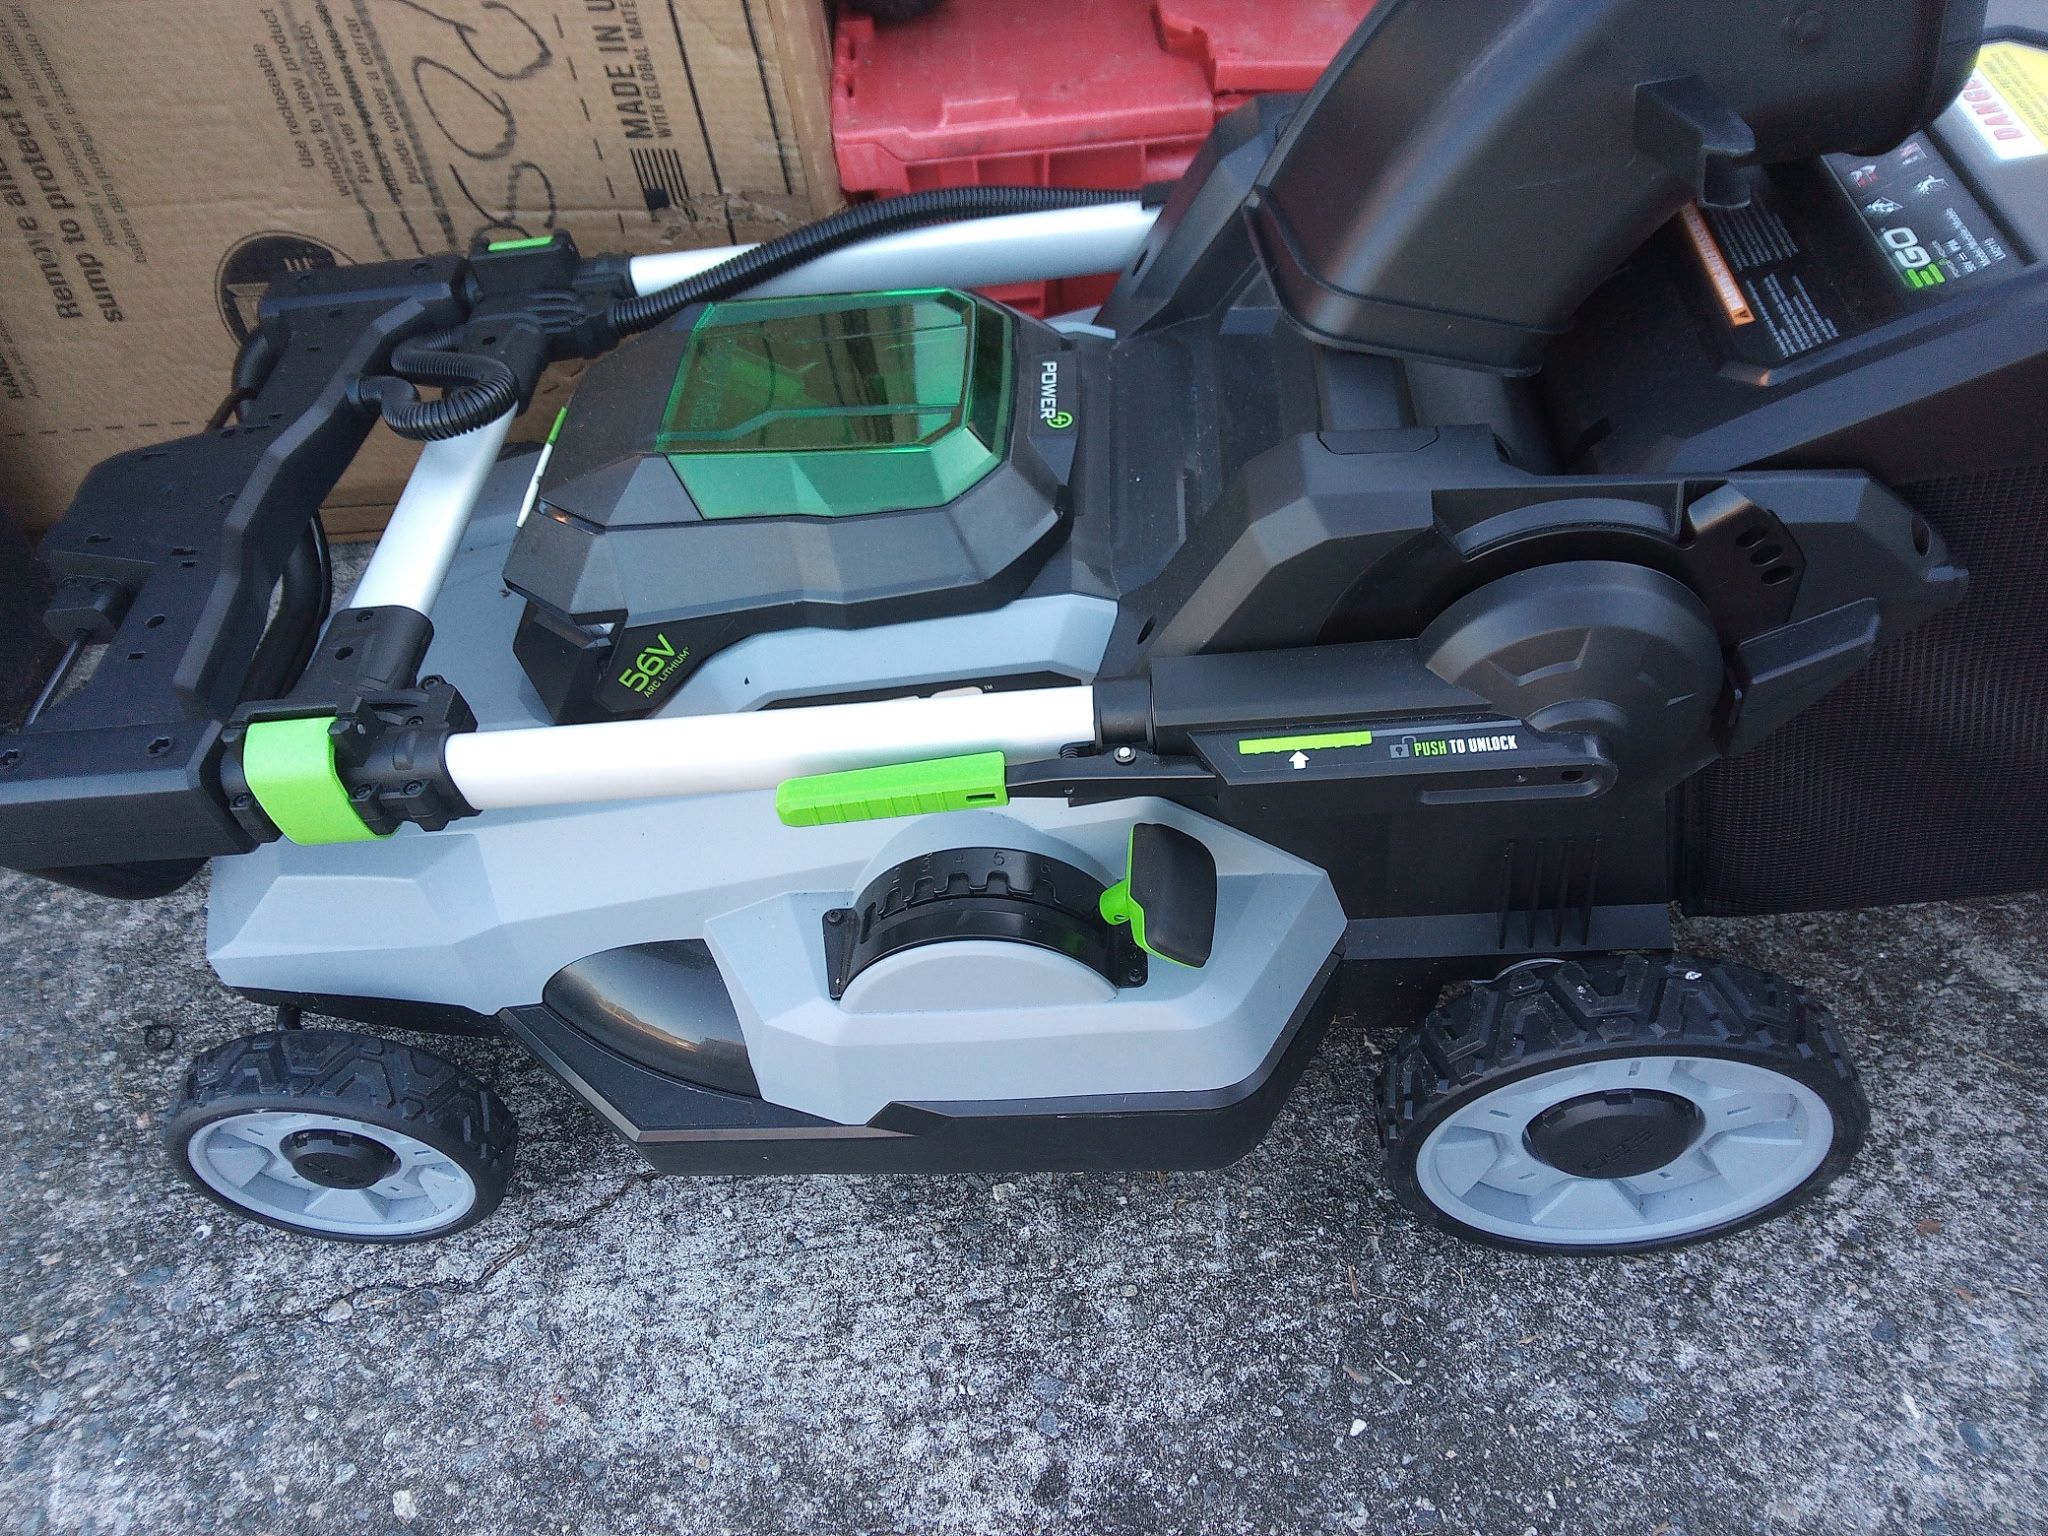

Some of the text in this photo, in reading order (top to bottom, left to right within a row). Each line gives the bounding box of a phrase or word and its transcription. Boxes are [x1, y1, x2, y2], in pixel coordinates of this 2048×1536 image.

[592, 25, 626, 51] IN
[634, 46, 661, 99] GLOBAL
[260, 8, 351, 196] window to view product
[325, 101, 345, 116] el
[343, 15, 423, 184] puede volver a cerrar
[604, 64, 654, 138] MADE
[339, 121, 356, 144] ver
[650, 104, 672, 137] WITH
[295, 139, 316, 168] Use
[351, 150, 373, 183] Para
[0, 110, 124, 322] sump to protect
[17, 215, 83, 318] Remove
[1883, 227, 1946, 288] EGO
[618, 633, 675, 692] 56V
[644, 680, 661, 698] ARC
[1414, 735, 1518, 757] PUSH TO UNLOCK
[992, 851, 1005, 866] 5
